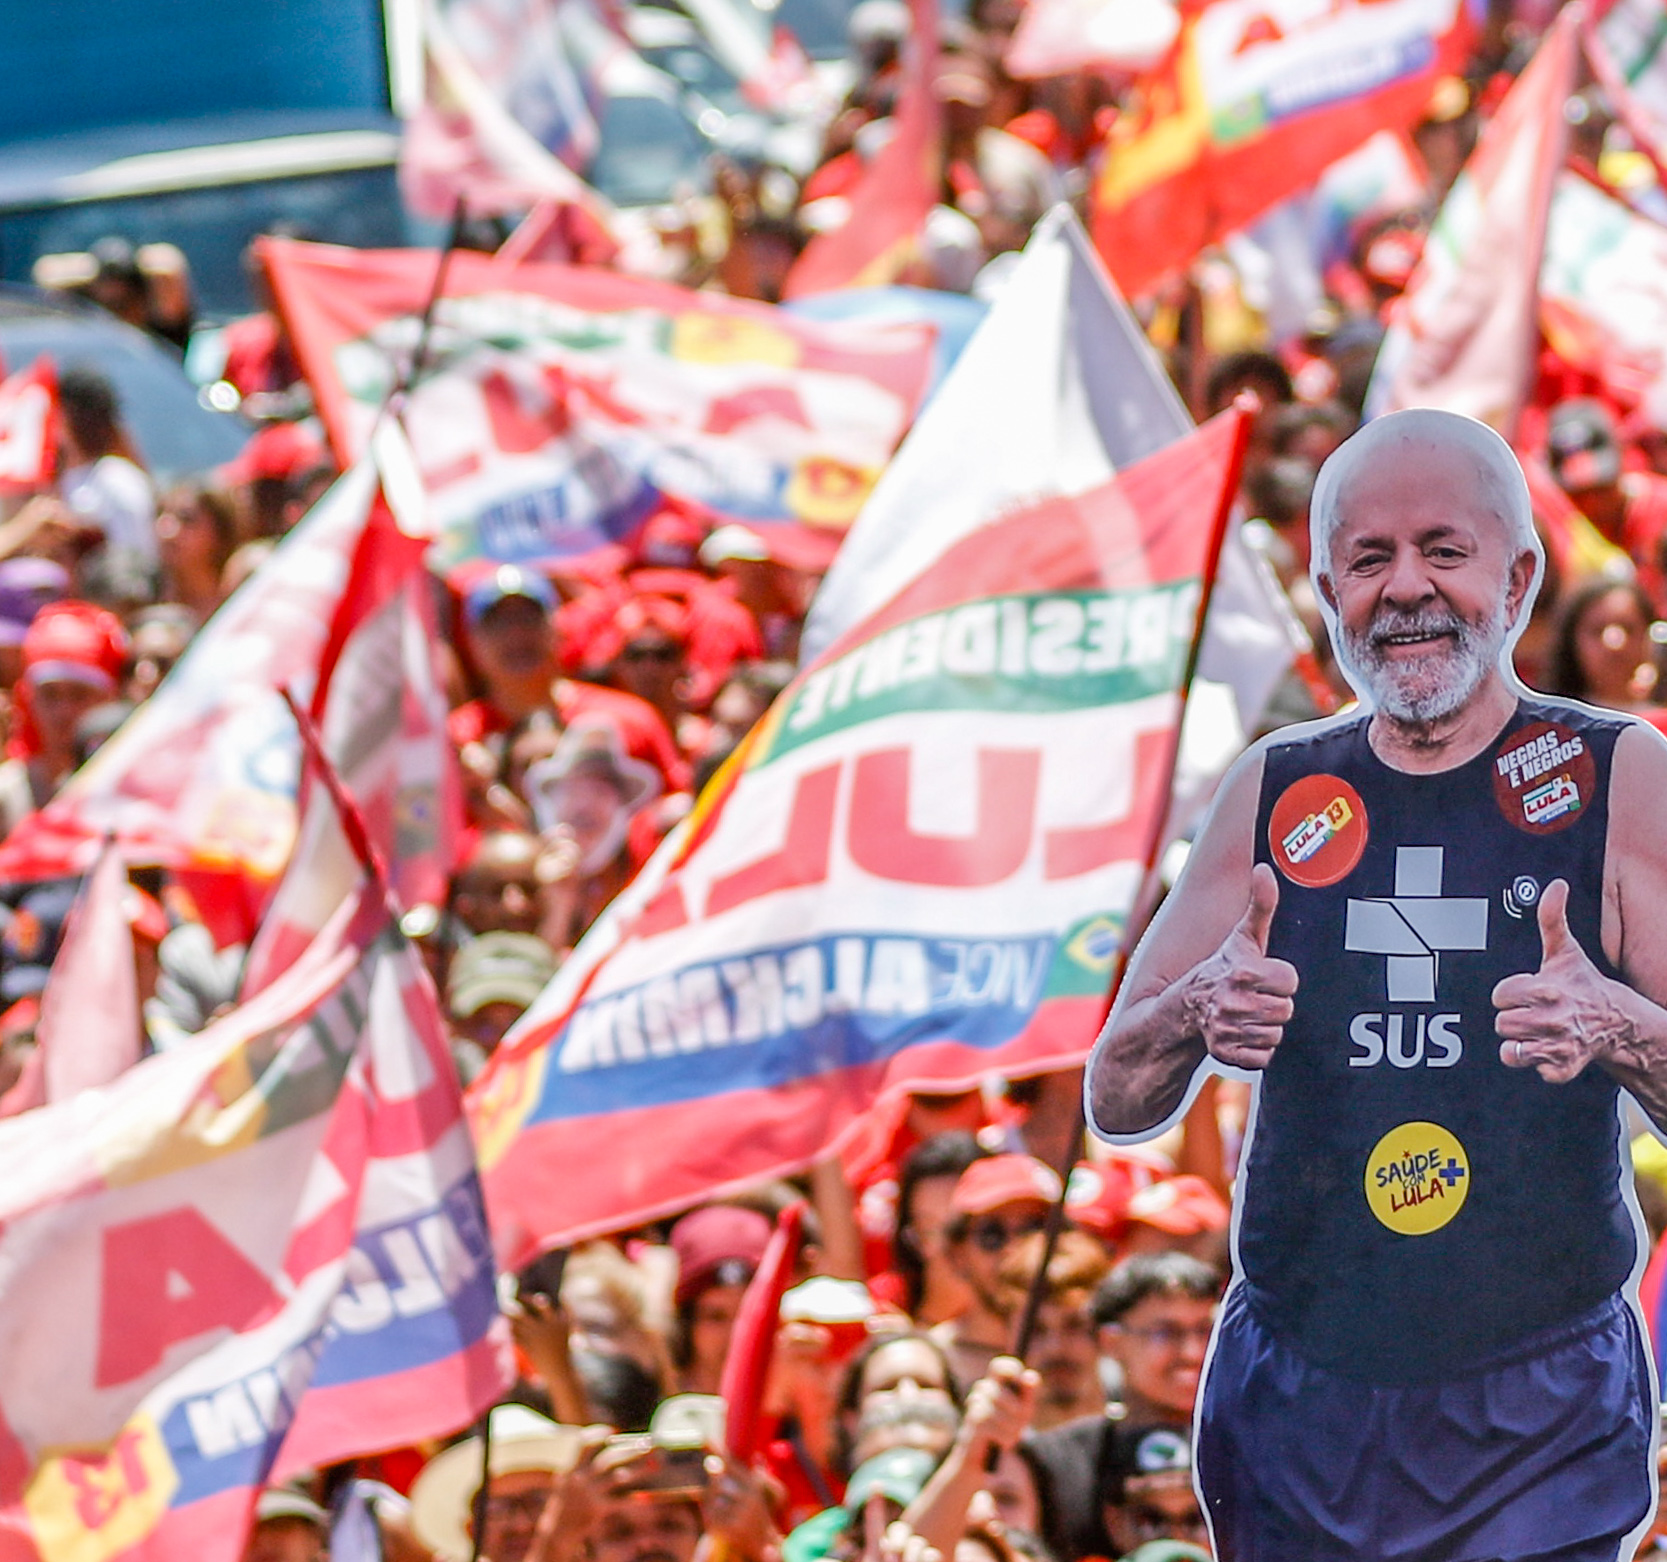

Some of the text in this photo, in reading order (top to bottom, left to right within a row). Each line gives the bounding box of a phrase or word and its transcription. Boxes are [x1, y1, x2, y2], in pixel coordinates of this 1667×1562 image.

[1496, 730, 1559, 776] NEGRAS
[1509, 735, 1584, 789] E NEGROS
[1526, 786, 1573, 815] LULA
[1288, 820, 1324, 857] LULA
[1326, 801, 1344, 824] 13
[1348, 1012, 1464, 1069] SUS
[1390, 1177, 1445, 1213] LULA
[1402, 1172, 1427, 1190] COM
